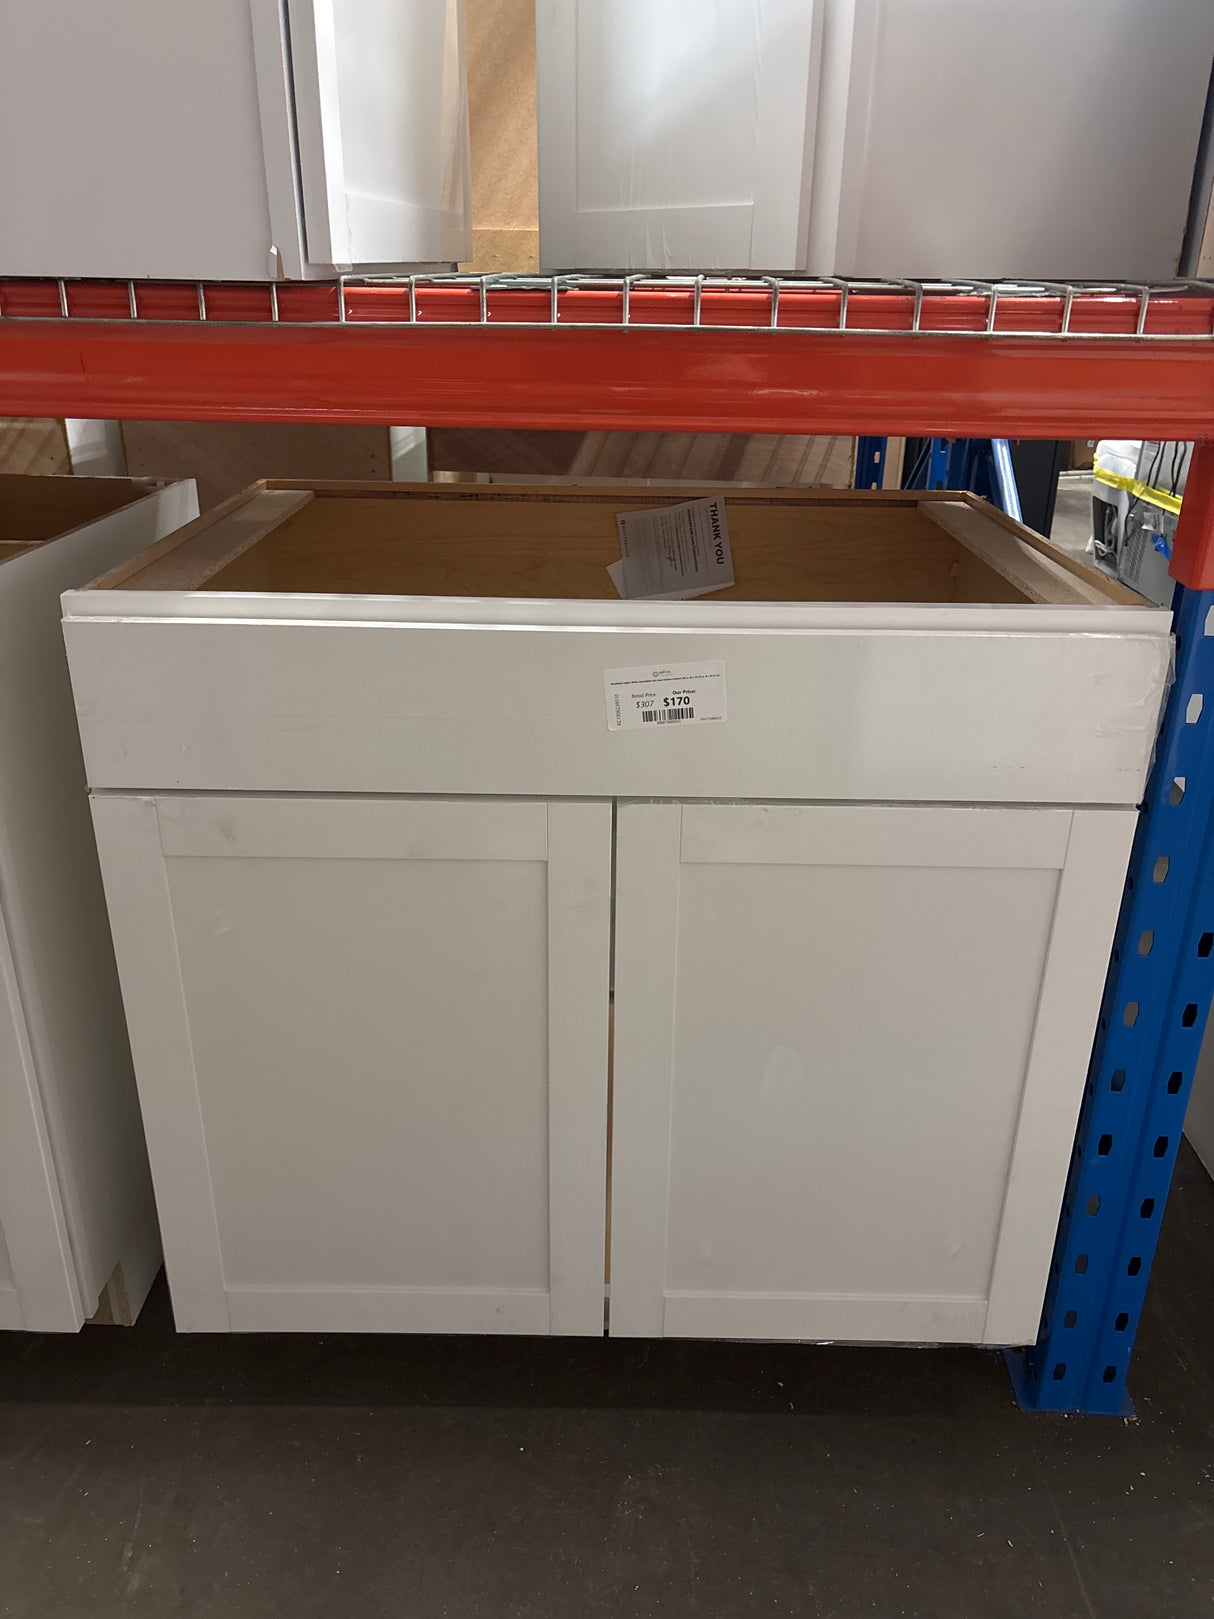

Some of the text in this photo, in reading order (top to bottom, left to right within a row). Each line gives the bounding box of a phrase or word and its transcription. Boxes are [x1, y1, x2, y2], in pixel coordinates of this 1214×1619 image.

[709, 502, 722, 540] THANK
[715, 540, 725, 565] YOU
[635, 700, 654, 708] $307
[663, 696, 690, 707] $170
